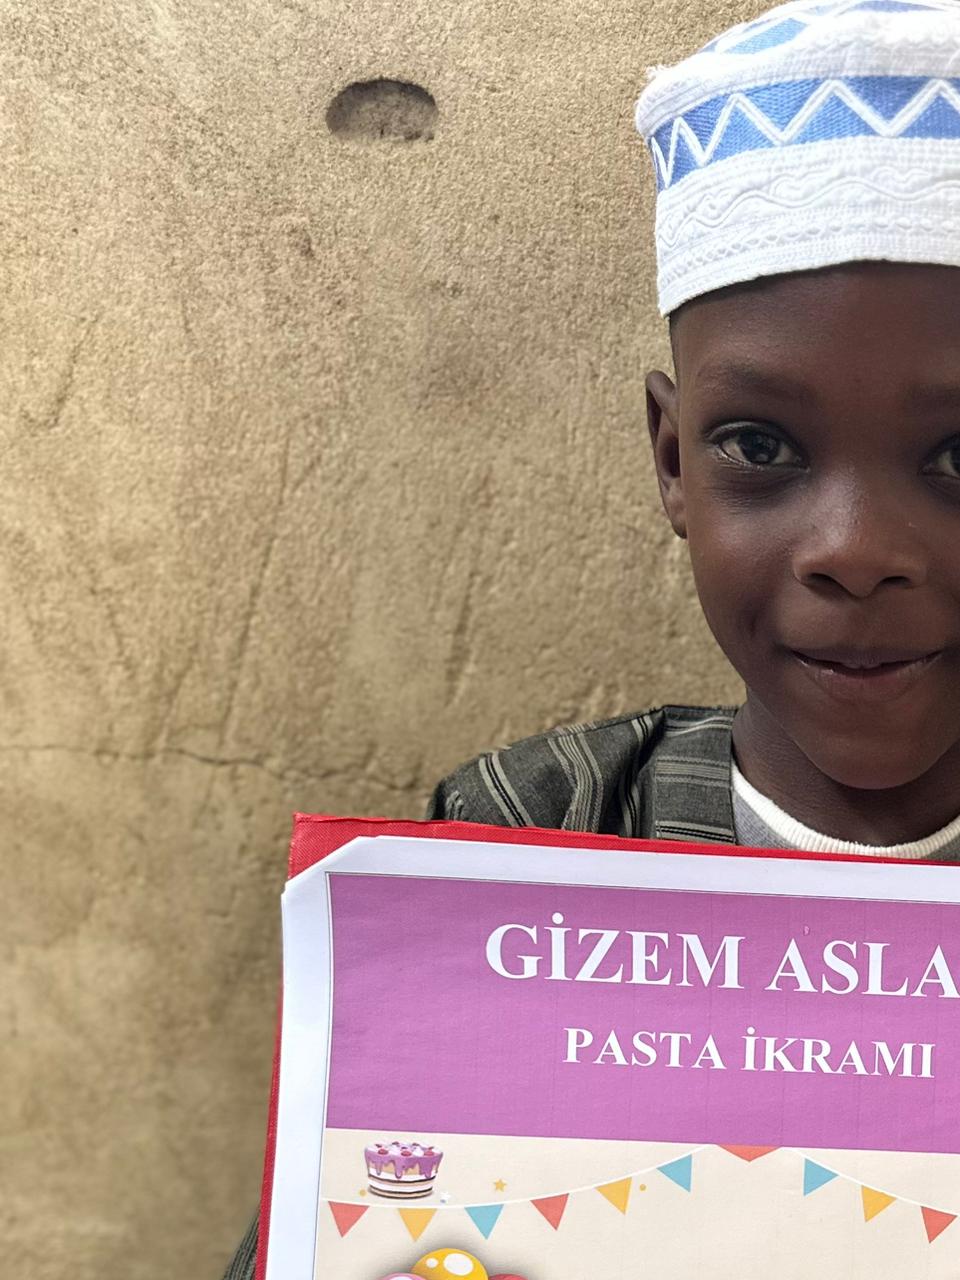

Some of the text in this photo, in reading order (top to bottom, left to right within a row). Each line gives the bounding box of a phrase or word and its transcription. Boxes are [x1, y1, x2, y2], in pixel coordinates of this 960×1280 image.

[485, 912, 746, 990] GİZEM
[562, 1026, 936, 1079] PASTA İKRAMI
